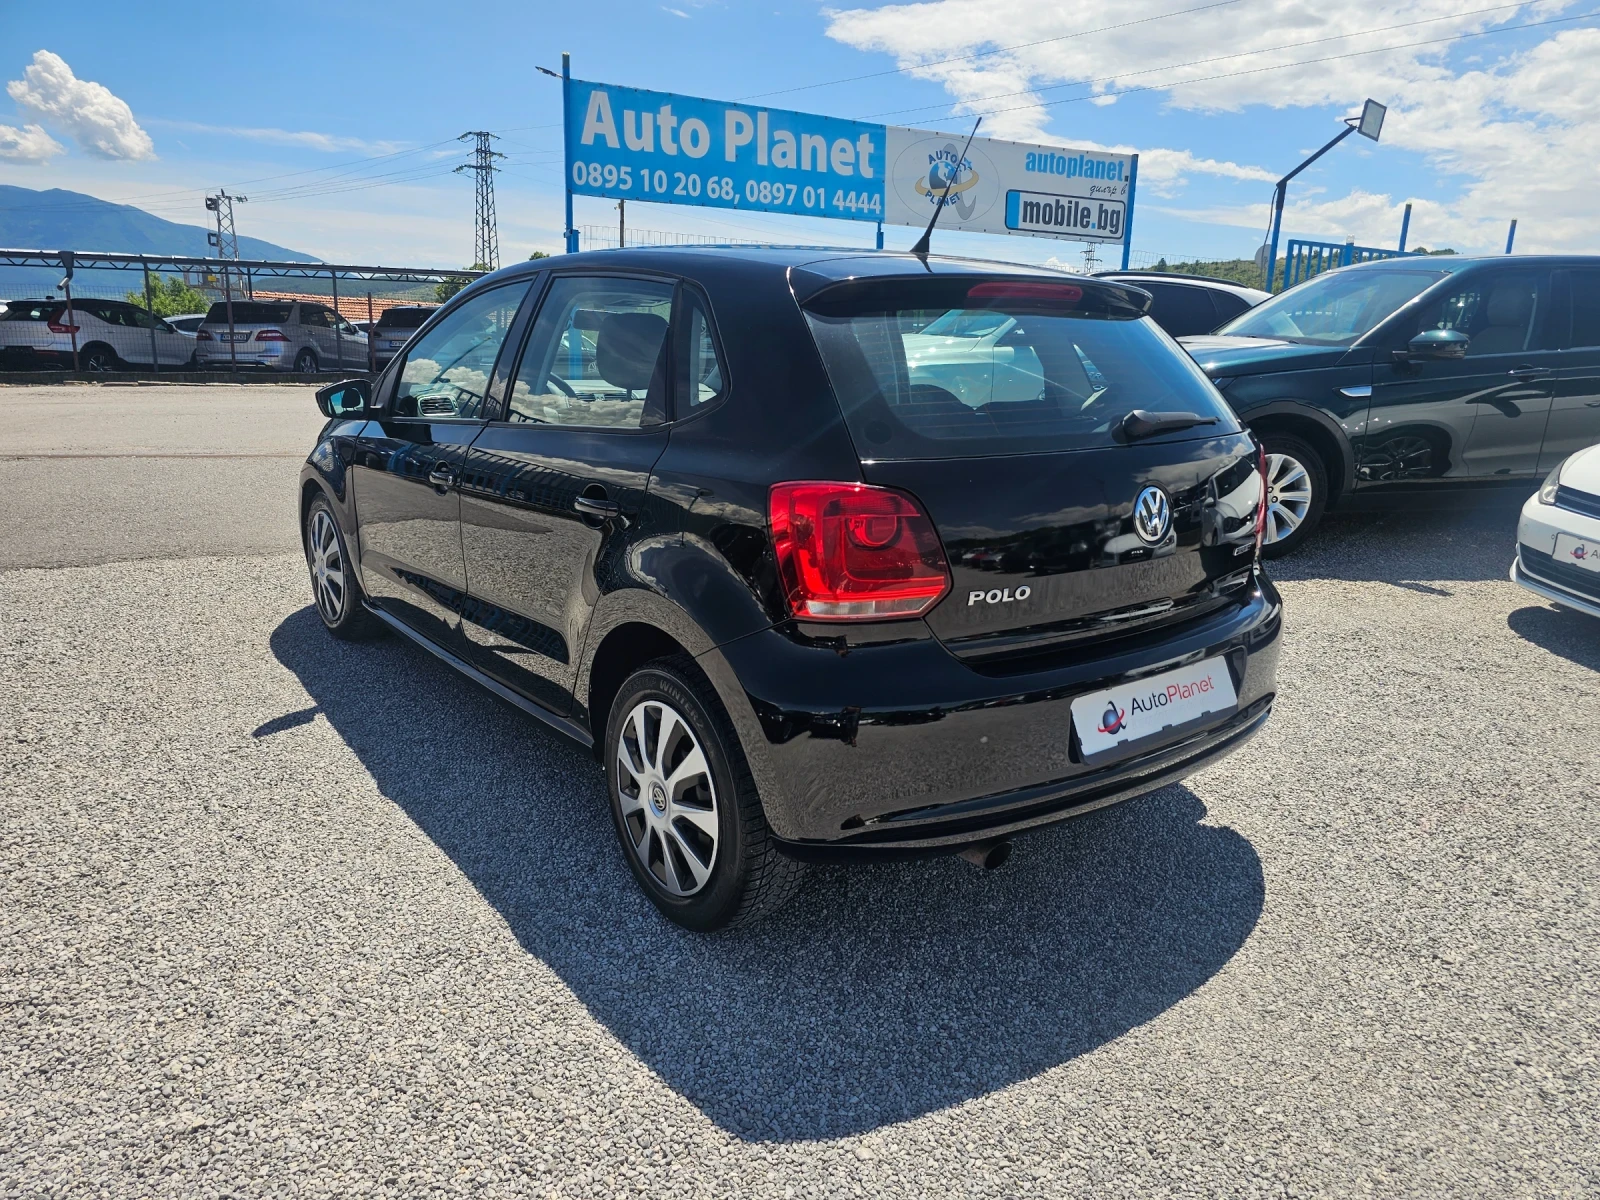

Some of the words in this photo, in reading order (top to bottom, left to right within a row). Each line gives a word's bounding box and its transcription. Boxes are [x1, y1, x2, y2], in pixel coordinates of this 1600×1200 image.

[580, 89, 711, 159] Auto
[724, 109, 875, 179] Planet
[928, 150, 958, 165] AUTO
[572, 160, 633, 190] 0895
[640, 168, 668, 193] 10
[674, 172, 701, 197] 20
[706, 176, 741, 205] 68,
[745, 179, 798, 206] 0897
[803, 185, 825, 209] 01
[832, 189, 882, 215] 4444
[1022, 199, 1121, 235] mobile.bg
[966, 585, 1031, 606] POLO
[1130, 675, 1215, 716] AutoPlanet
